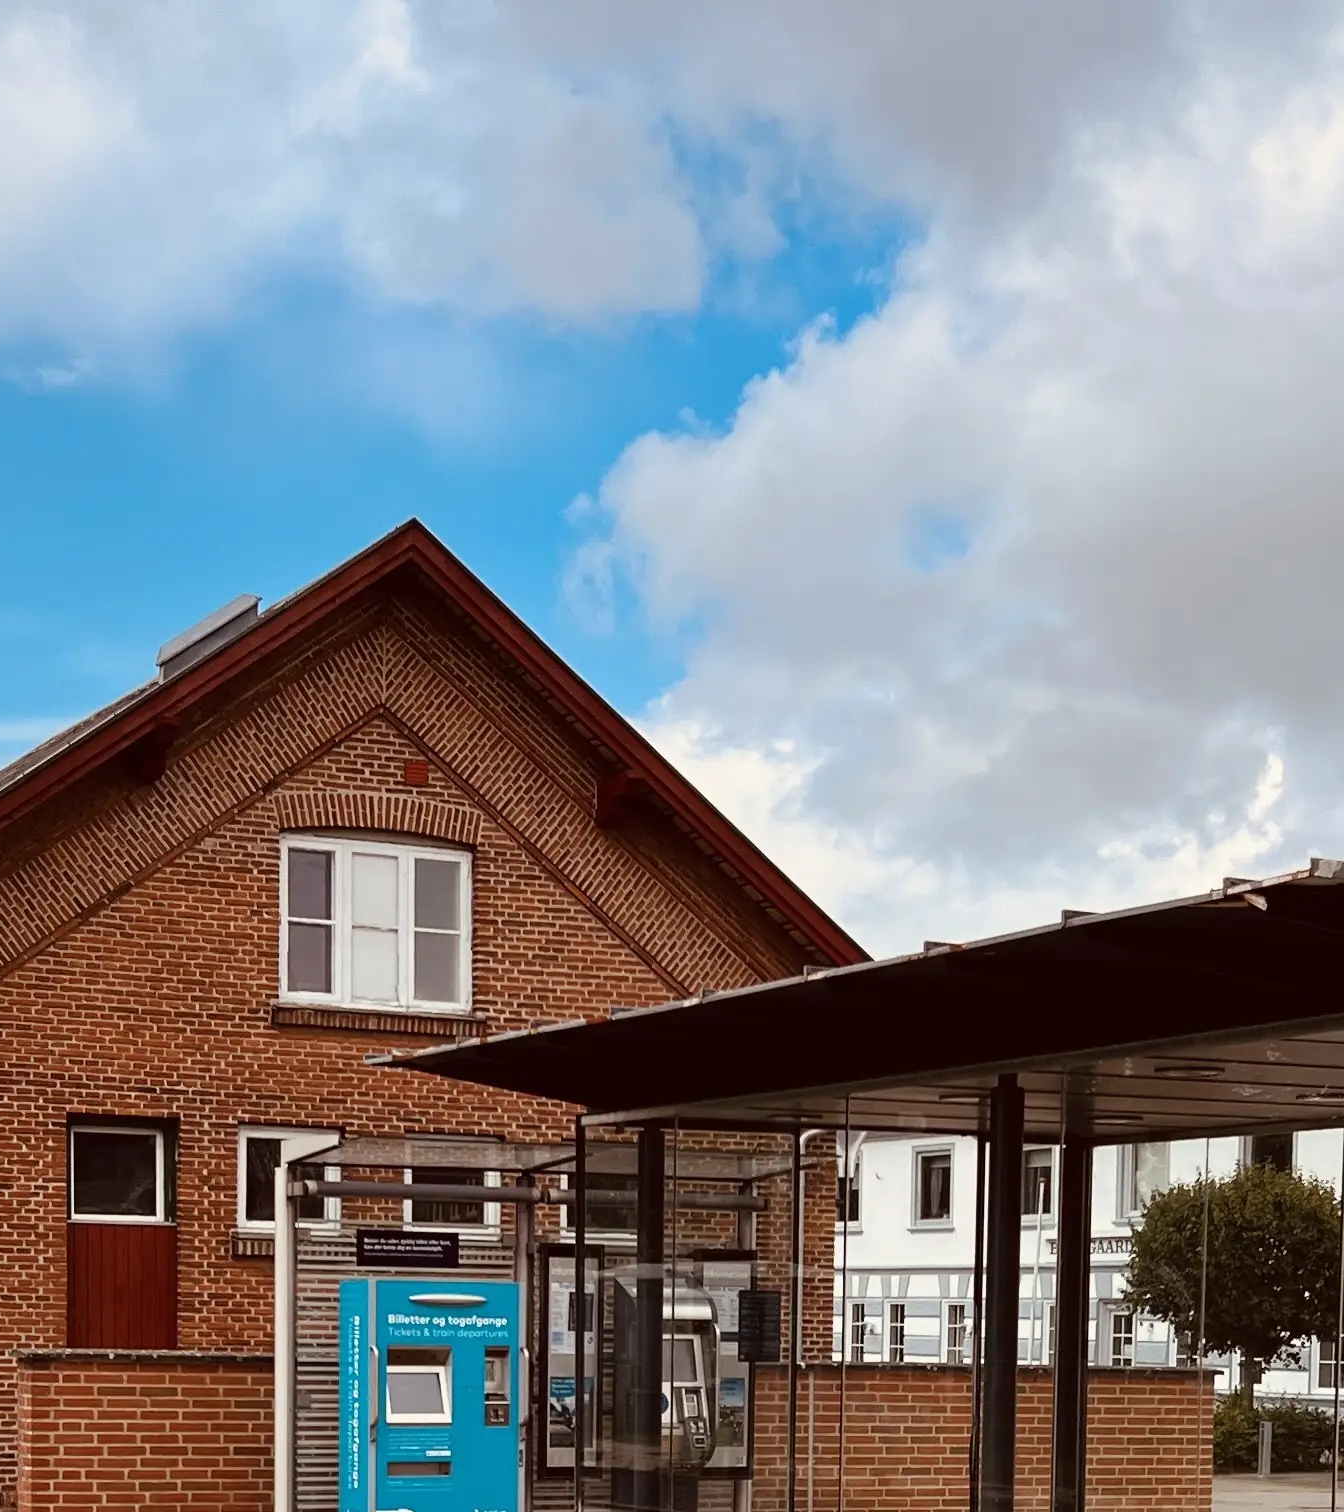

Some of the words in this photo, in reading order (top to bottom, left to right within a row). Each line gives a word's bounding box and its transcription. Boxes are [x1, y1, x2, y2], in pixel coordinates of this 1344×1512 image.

[387, 1313, 430, 1325] Billetter
[432, 1316, 446, 1328] og
[448, 1315, 508, 1328] togafgange
[388, 1327, 421, 1337] Tickets
[424, 1327, 430, 1337] &
[433, 1329, 455, 1338] train
[457, 1329, 509, 1339] departures
